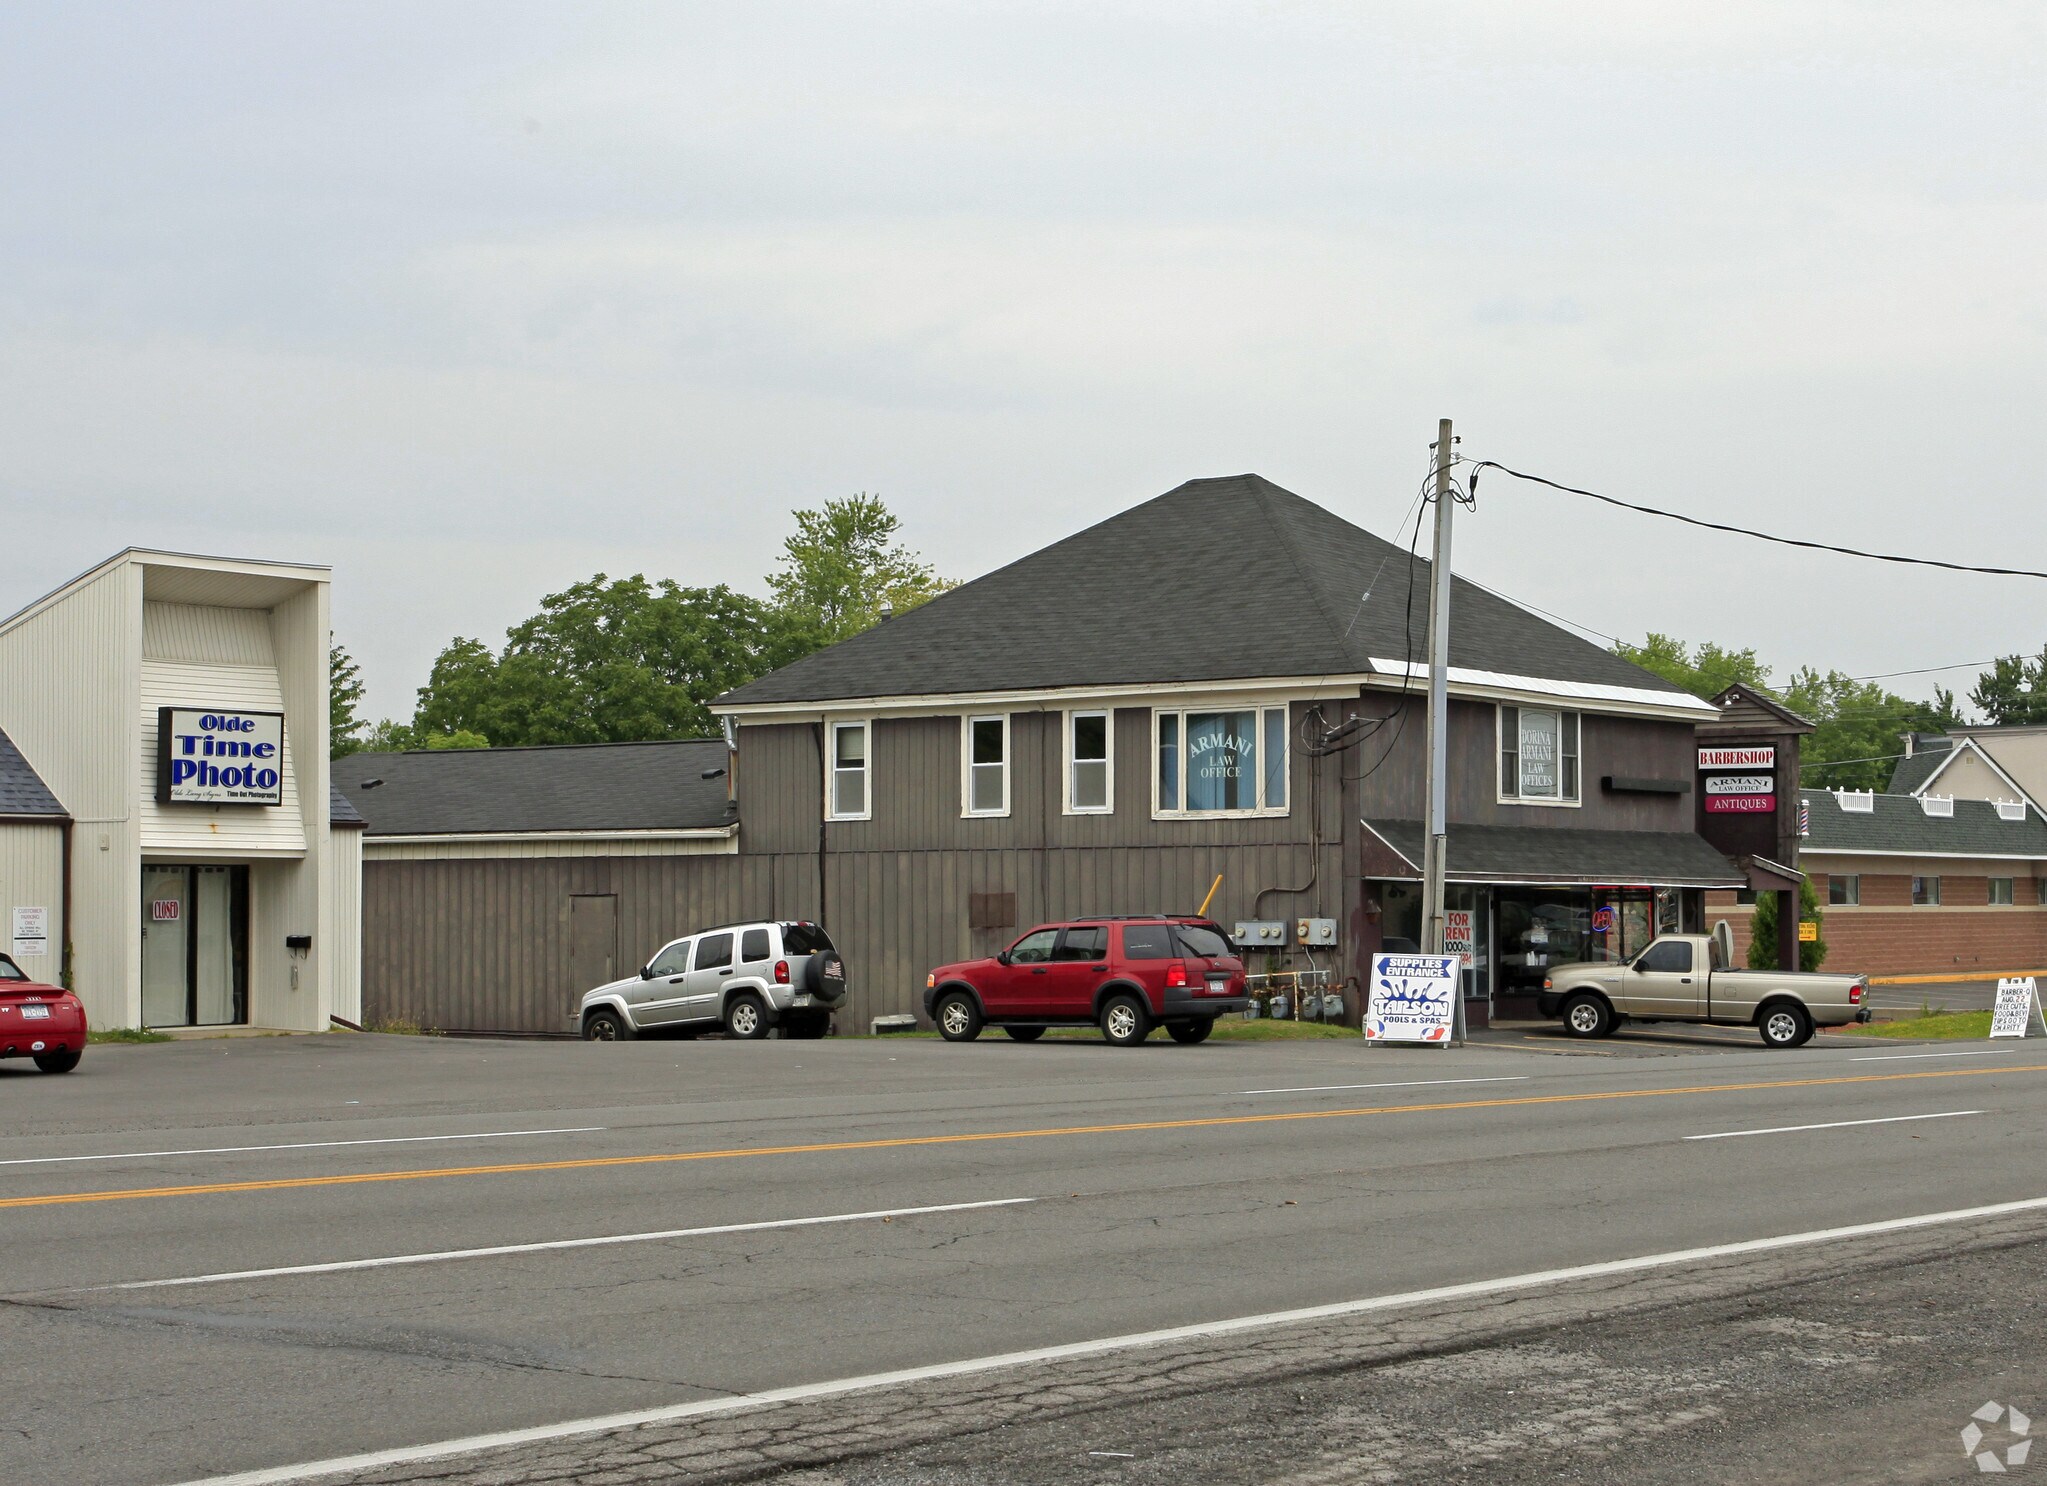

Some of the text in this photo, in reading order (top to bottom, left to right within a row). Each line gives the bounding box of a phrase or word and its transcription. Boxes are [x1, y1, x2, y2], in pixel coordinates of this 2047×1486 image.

[199, 714, 256, 733] Olde
[1522, 729, 1551, 745] DORINA
[174, 735, 276, 759] Time
[1190, 732, 1253, 759] ARMANI
[1521, 745, 1551, 760] ARMANI
[1700, 751, 1773, 765] BARBERSHOP
[1209, 755, 1235, 766] LAW
[171, 759, 279, 790] Photo
[1200, 766, 1242, 778] OFFICE
[1527, 762, 1545, 774] LAW
[1521, 774, 1553, 786] OFFICES
[1710, 778, 1769, 788] ARMANI
[248, 791, 277, 799] Photography
[1714, 799, 1767, 810] ANTIQUES
[154, 901, 178, 918] CLOSED
[1448, 913, 1468, 926] FOR
[1592, 911, 1612, 926] OPEN
[1445, 927, 1471, 941] RENT
[1389, 957, 1443, 968] SUPPLIES
[1385, 967, 1445, 977] ENTRANCE
[1373, 998, 1449, 1017] TARSON
[1383, 1016, 1409, 1024] POOLS
